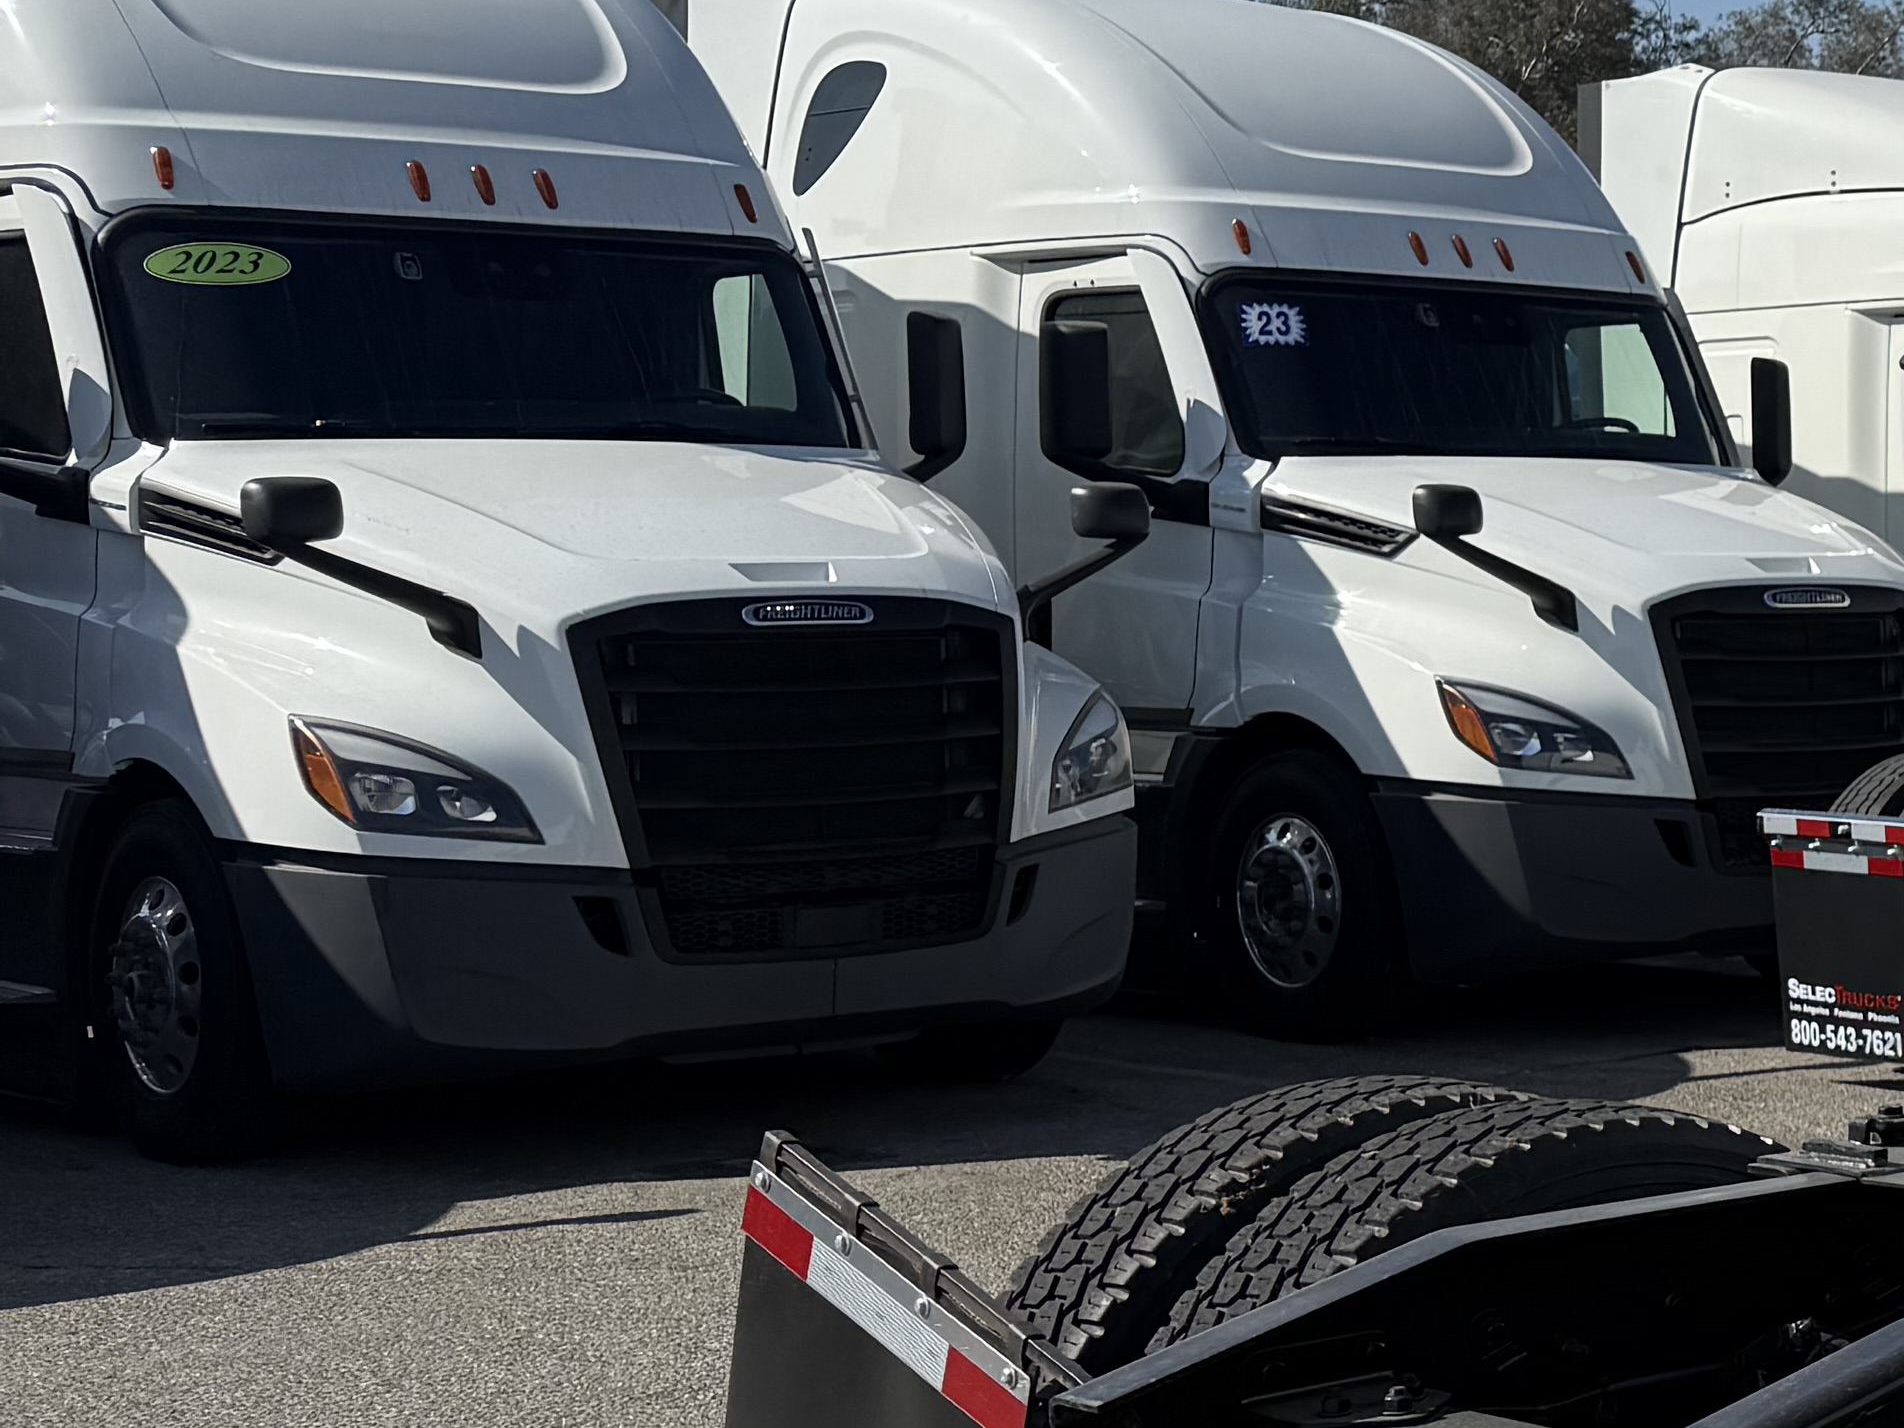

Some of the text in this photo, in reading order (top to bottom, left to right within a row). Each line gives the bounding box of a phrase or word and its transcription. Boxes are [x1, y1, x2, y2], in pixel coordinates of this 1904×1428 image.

[167, 250, 264, 275] 2023
[1257, 310, 1291, 336] 23
[758, 604, 860, 620] FREIGHTLINER
[1789, 1002, 1802, 1012] Los
[1790, 1018, 1903, 1058] 800-543-7621
